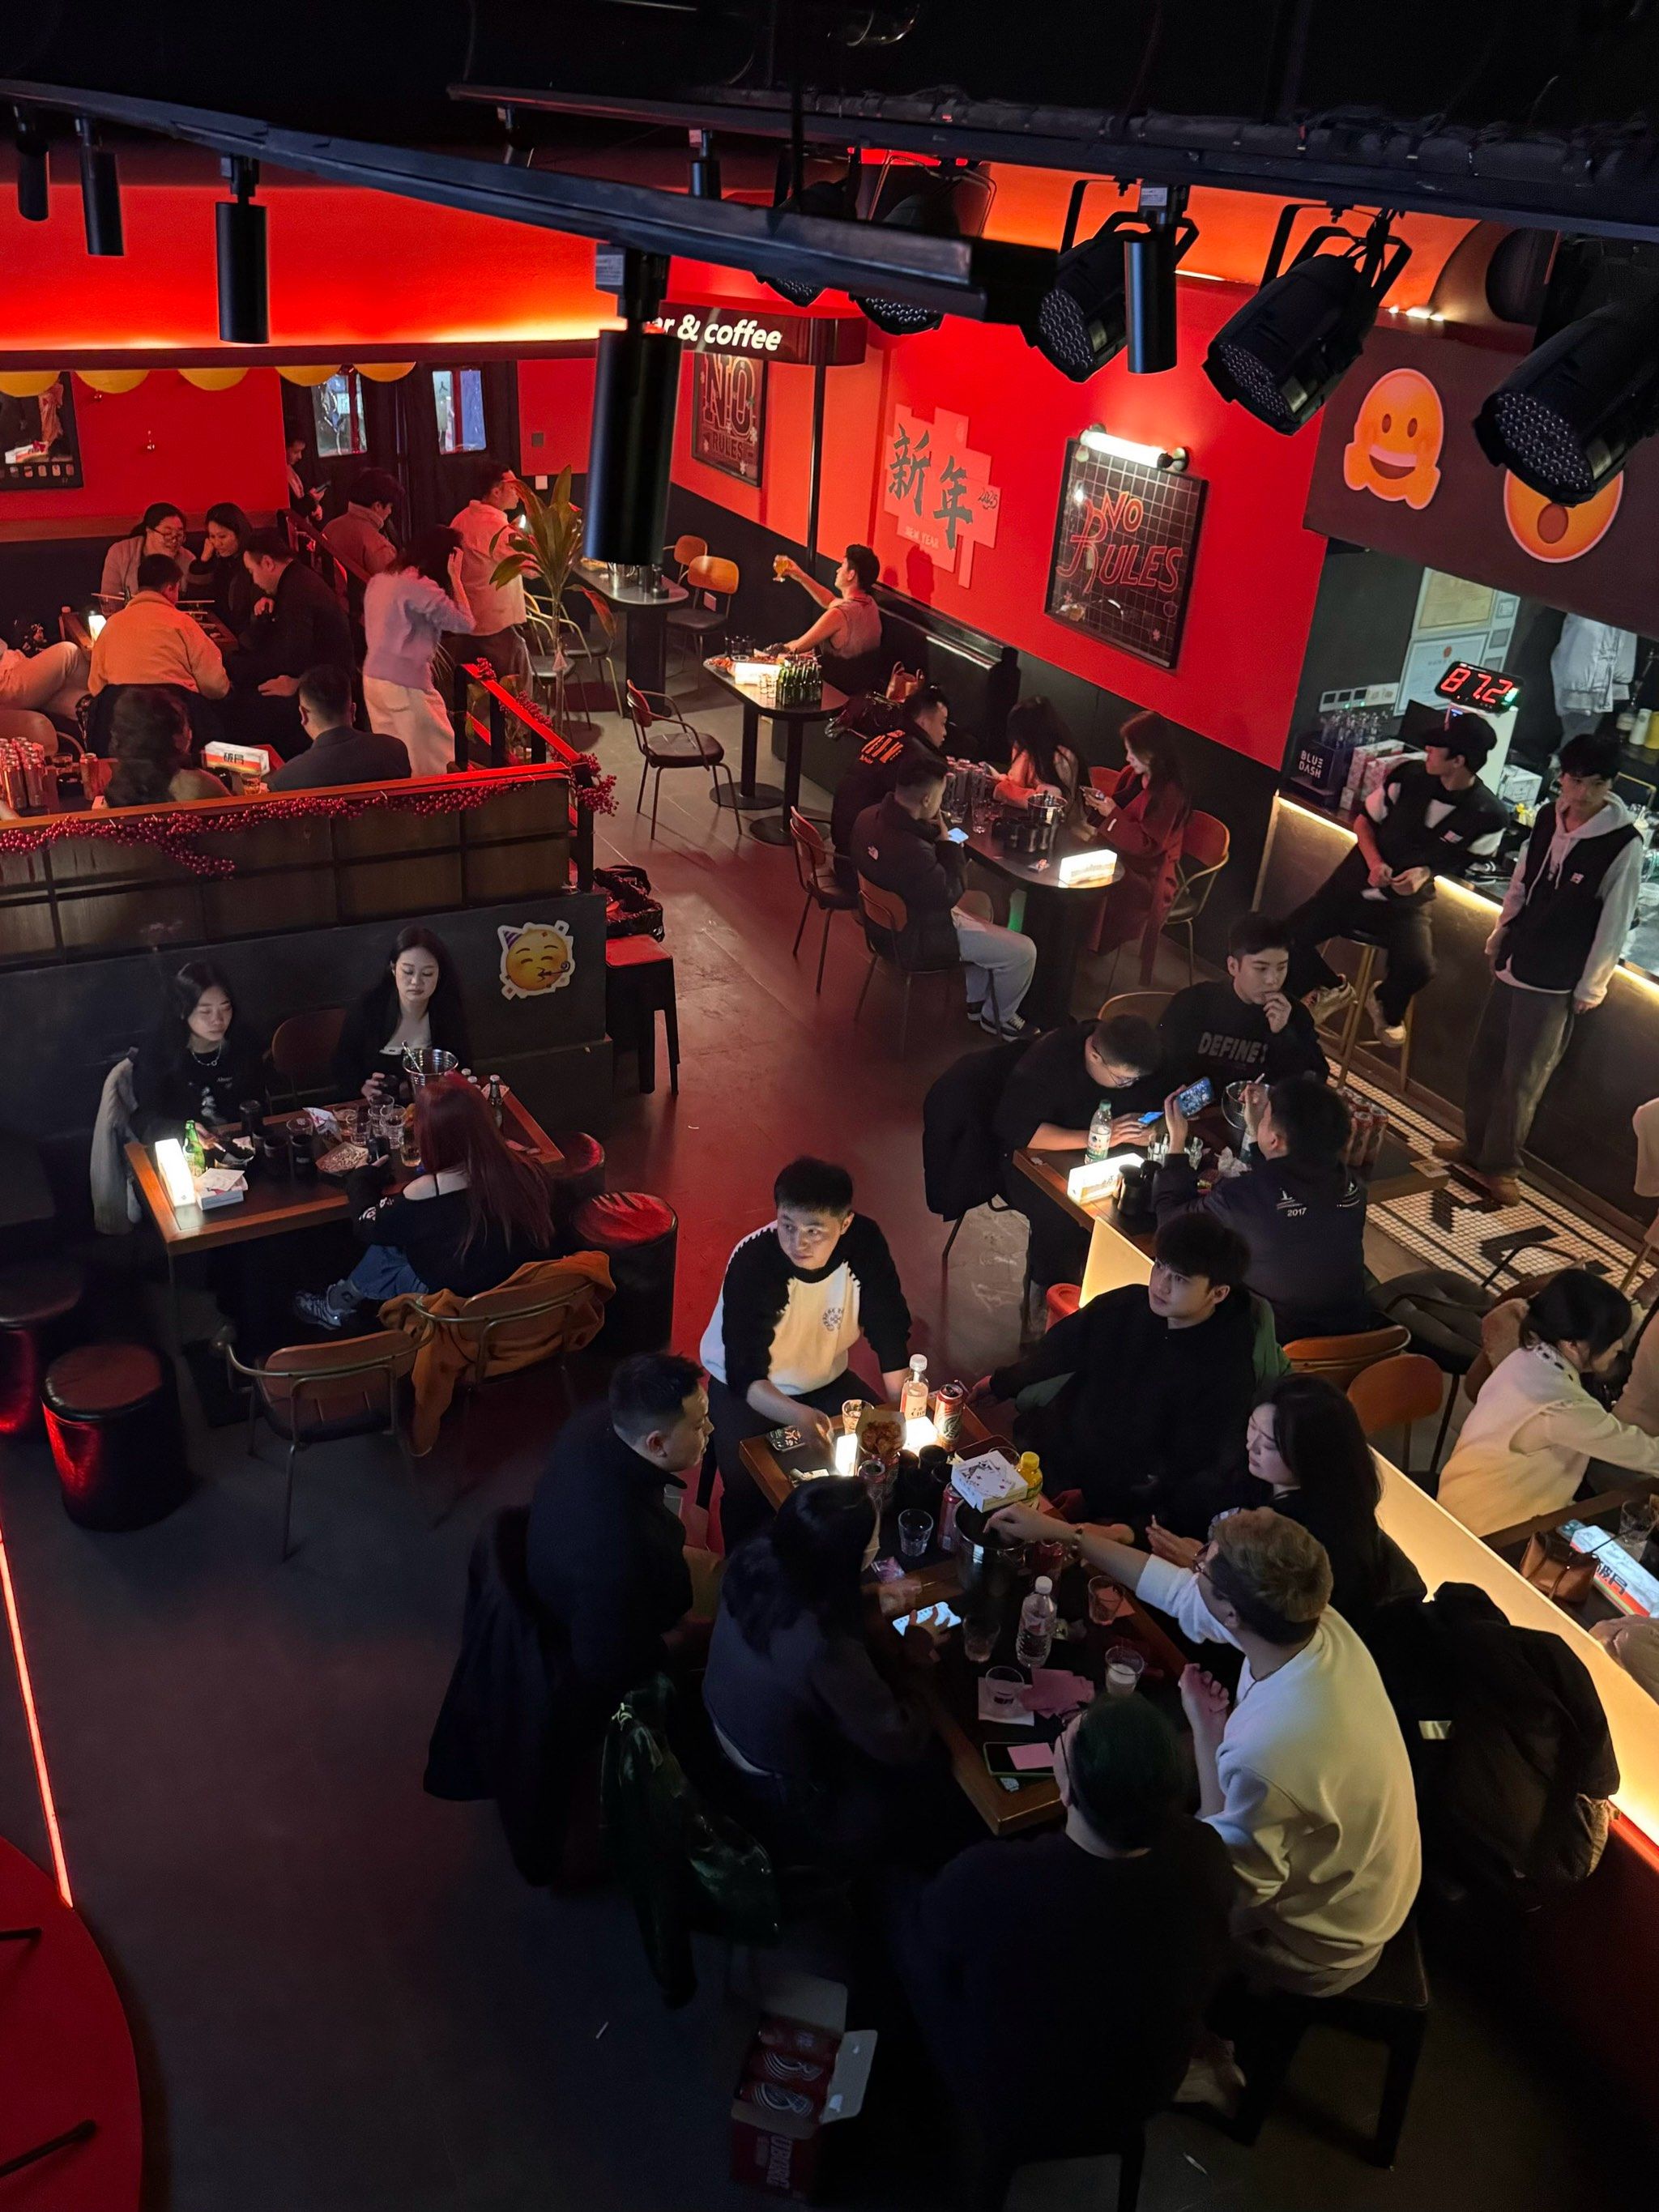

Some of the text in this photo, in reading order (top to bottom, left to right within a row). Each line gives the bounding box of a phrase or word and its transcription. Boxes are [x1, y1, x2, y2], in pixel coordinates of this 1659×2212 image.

[677, 314, 701, 342] &
[704, 319, 783, 352] coffee
[703, 353, 756, 437] NO
[712, 433, 743, 458] RULES
[888, 423, 973, 550] 新年
[1102, 491, 1144, 532] NO
[1056, 498, 1183, 594] RULES
[1299, 762, 1322, 779] DASH
[1300, 750, 1324, 769] BLUE
[1287, 1207, 1307, 1217] 2017
